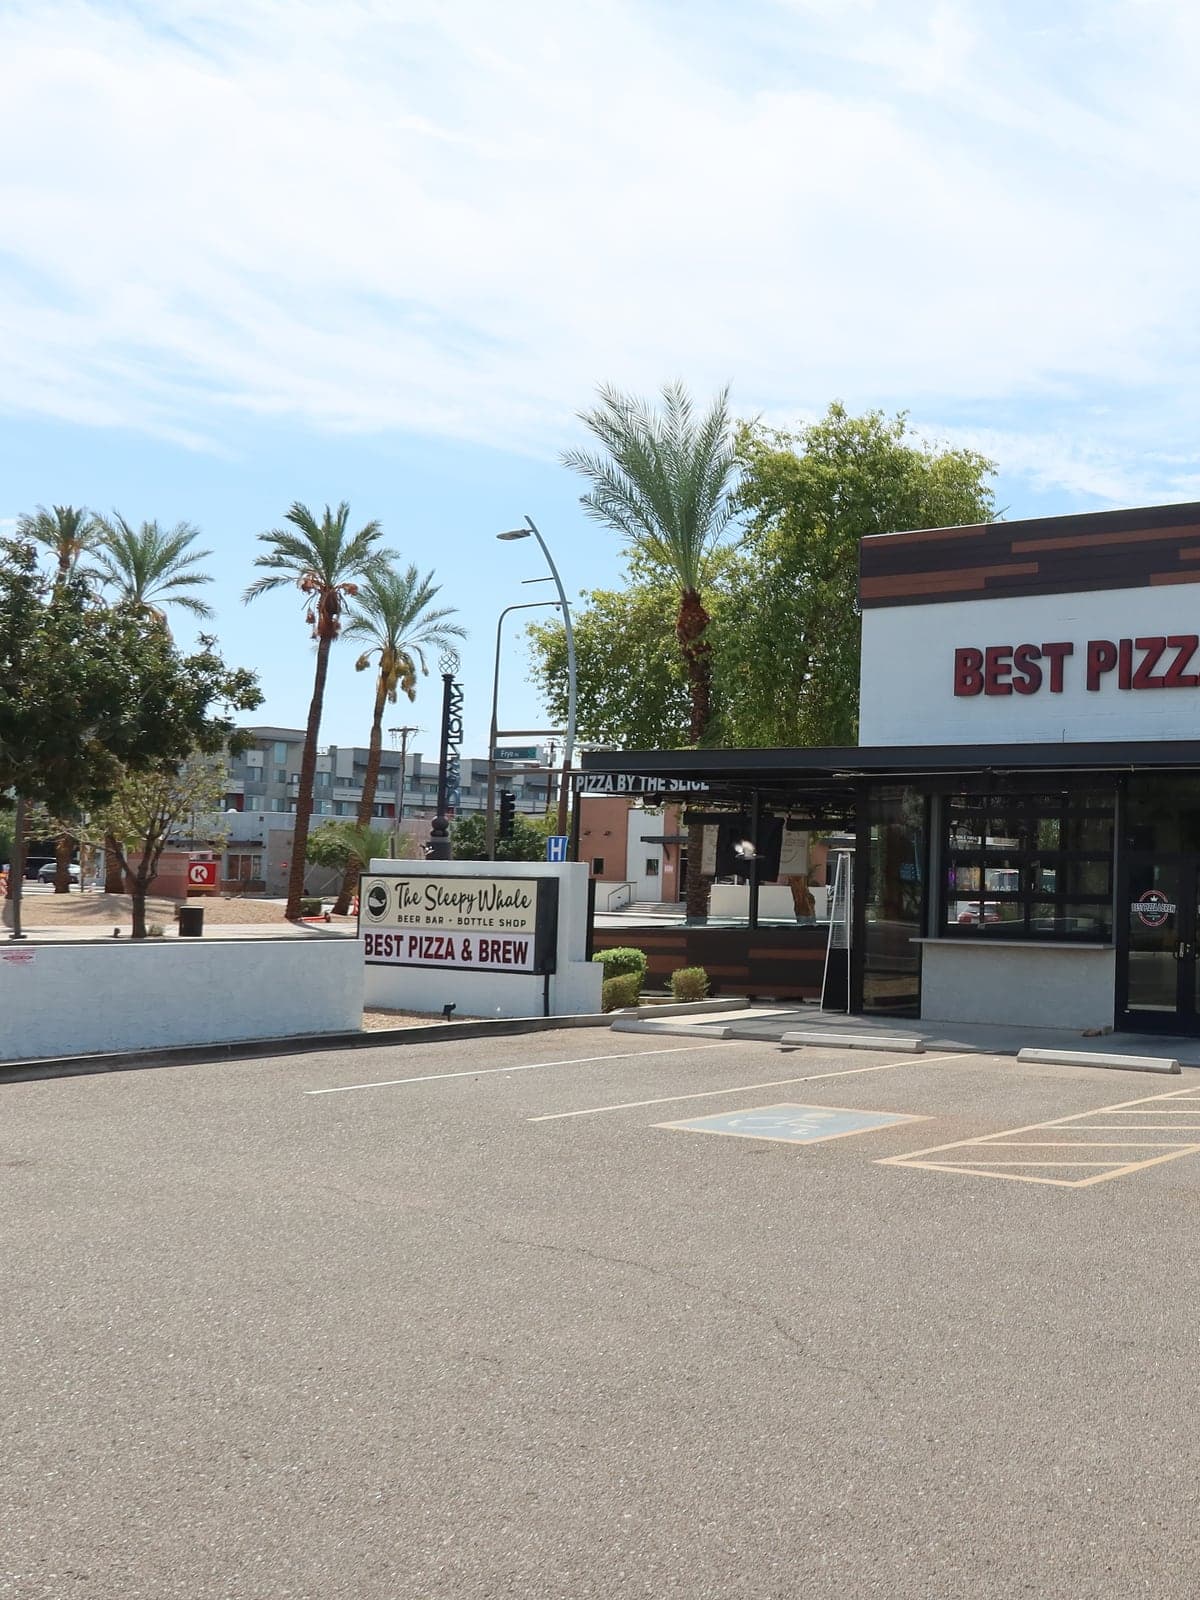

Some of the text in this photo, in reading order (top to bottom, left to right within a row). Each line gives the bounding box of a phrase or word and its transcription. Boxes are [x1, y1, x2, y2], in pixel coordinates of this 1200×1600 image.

[954, 642, 1074, 698] BEST
[576, 775, 613, 792] PIZZA
[617, 774, 635, 791] BY
[639, 776, 665, 791] THE
[552, 839, 563, 861] H
[395, 882, 532, 914] The Sleepy Whale
[397, 914, 527, 928] BEER BAR BOTTLE SHOP
[365, 933, 528, 965] BEST PIZZA & BREW
